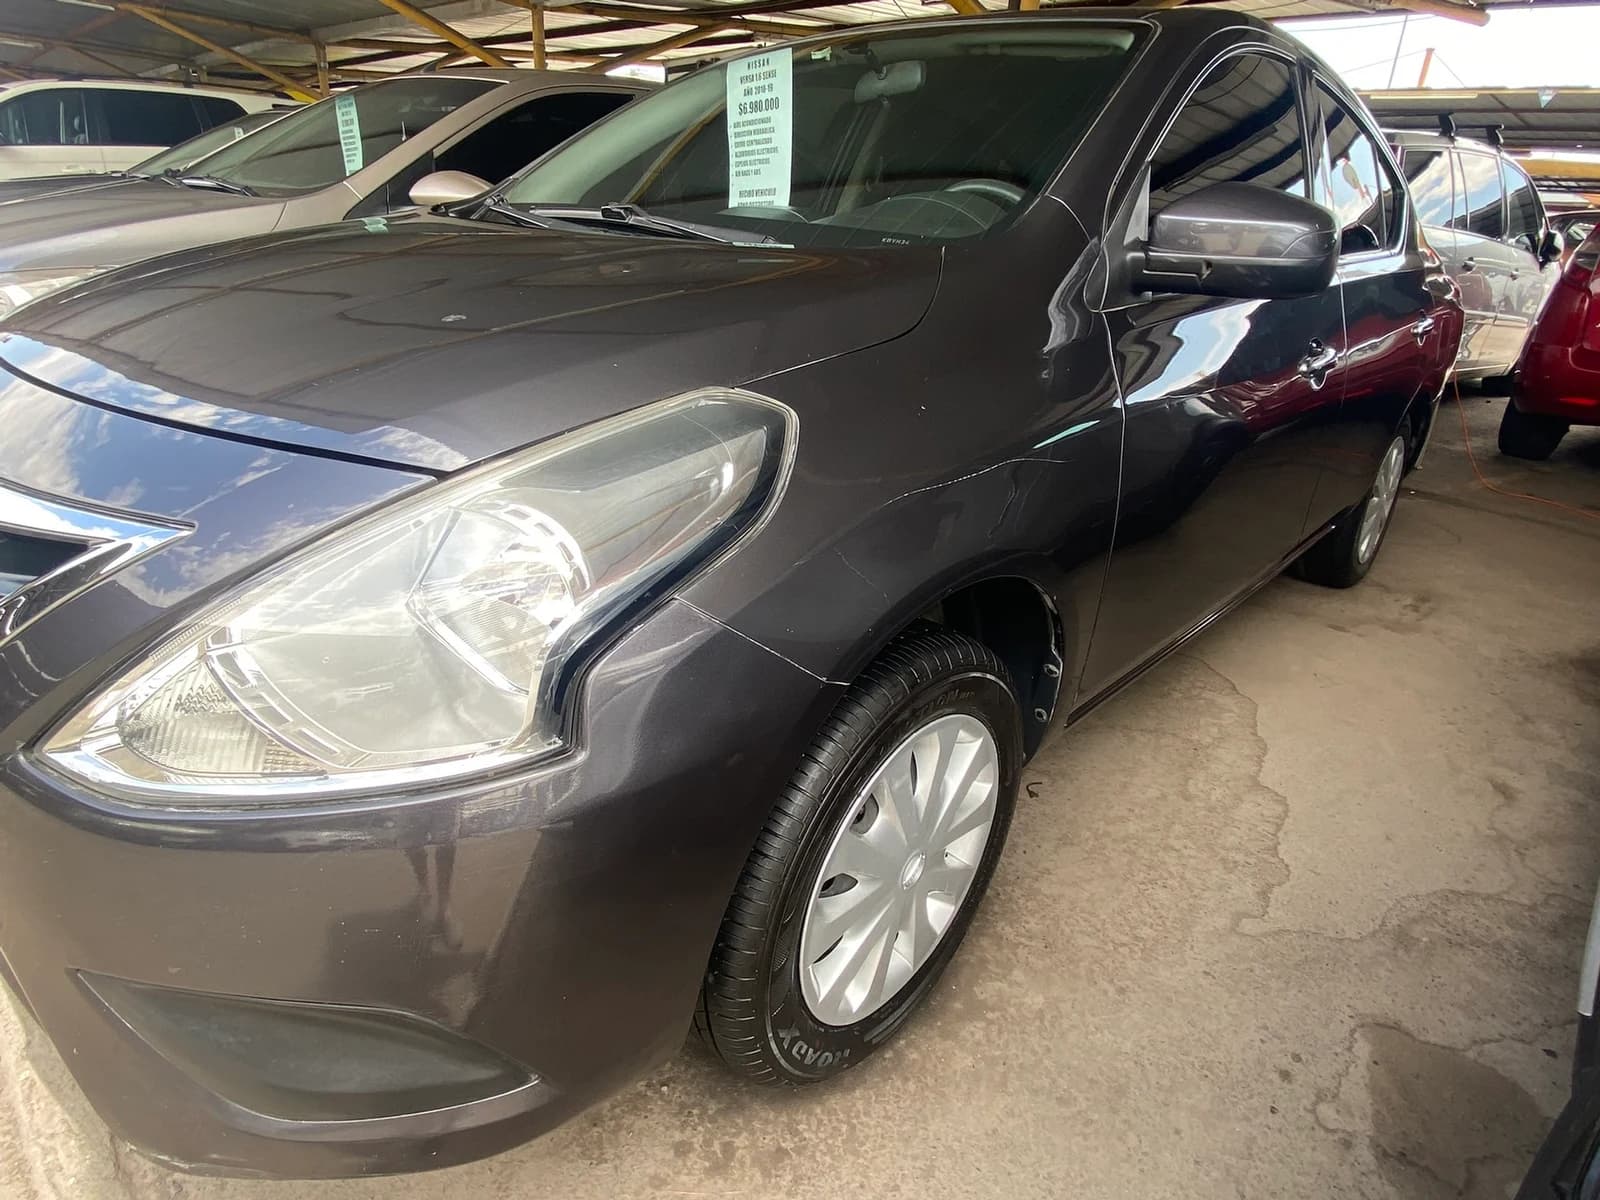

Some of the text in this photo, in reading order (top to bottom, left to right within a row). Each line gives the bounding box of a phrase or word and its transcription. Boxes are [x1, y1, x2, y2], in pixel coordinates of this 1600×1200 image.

[748, 58, 769, 70] NISSAN
[740, 74, 754, 84] VERSA
[739, 97, 779, 115] $6.980.000
